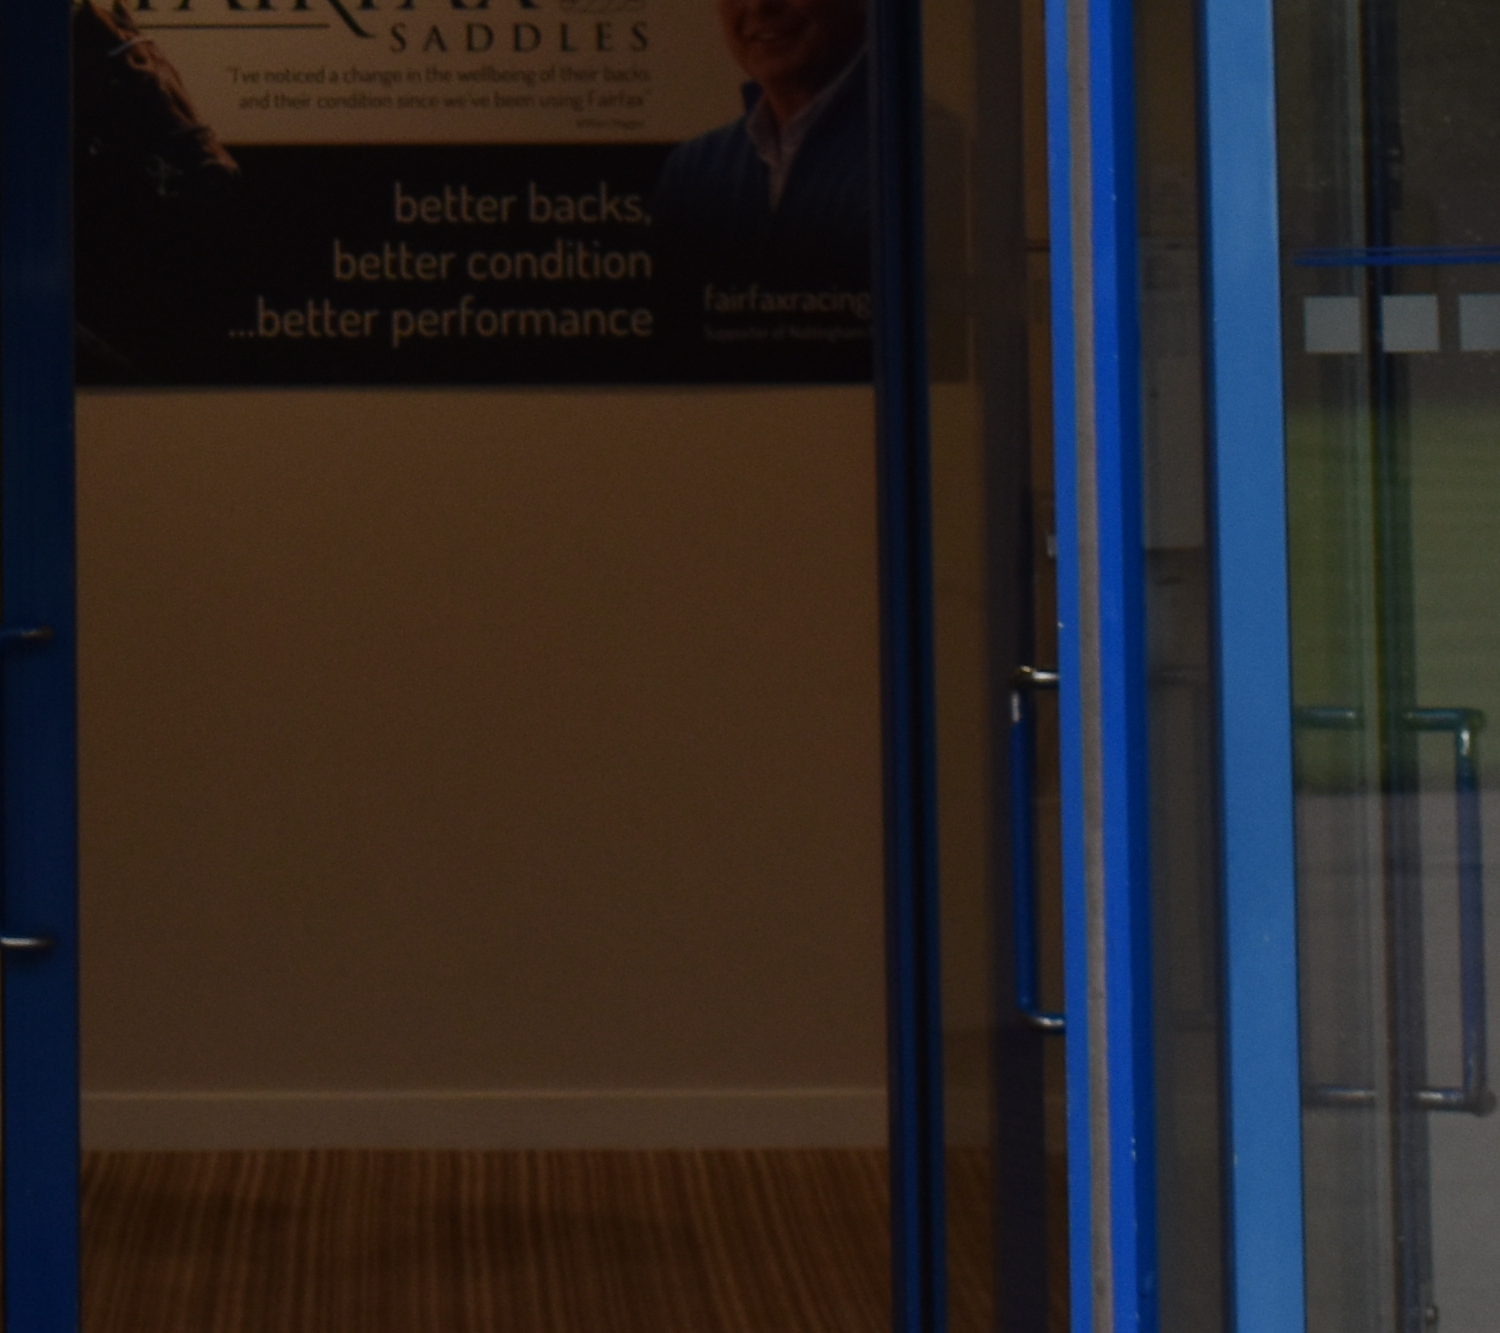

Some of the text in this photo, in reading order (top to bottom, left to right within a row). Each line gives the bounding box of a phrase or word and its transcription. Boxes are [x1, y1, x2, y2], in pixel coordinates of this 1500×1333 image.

[391, 21, 649, 53] SADDLES
[394, 182, 651, 224] better backs,
[334, 238, 651, 280] better condition
[392, 294, 653, 347] performance
